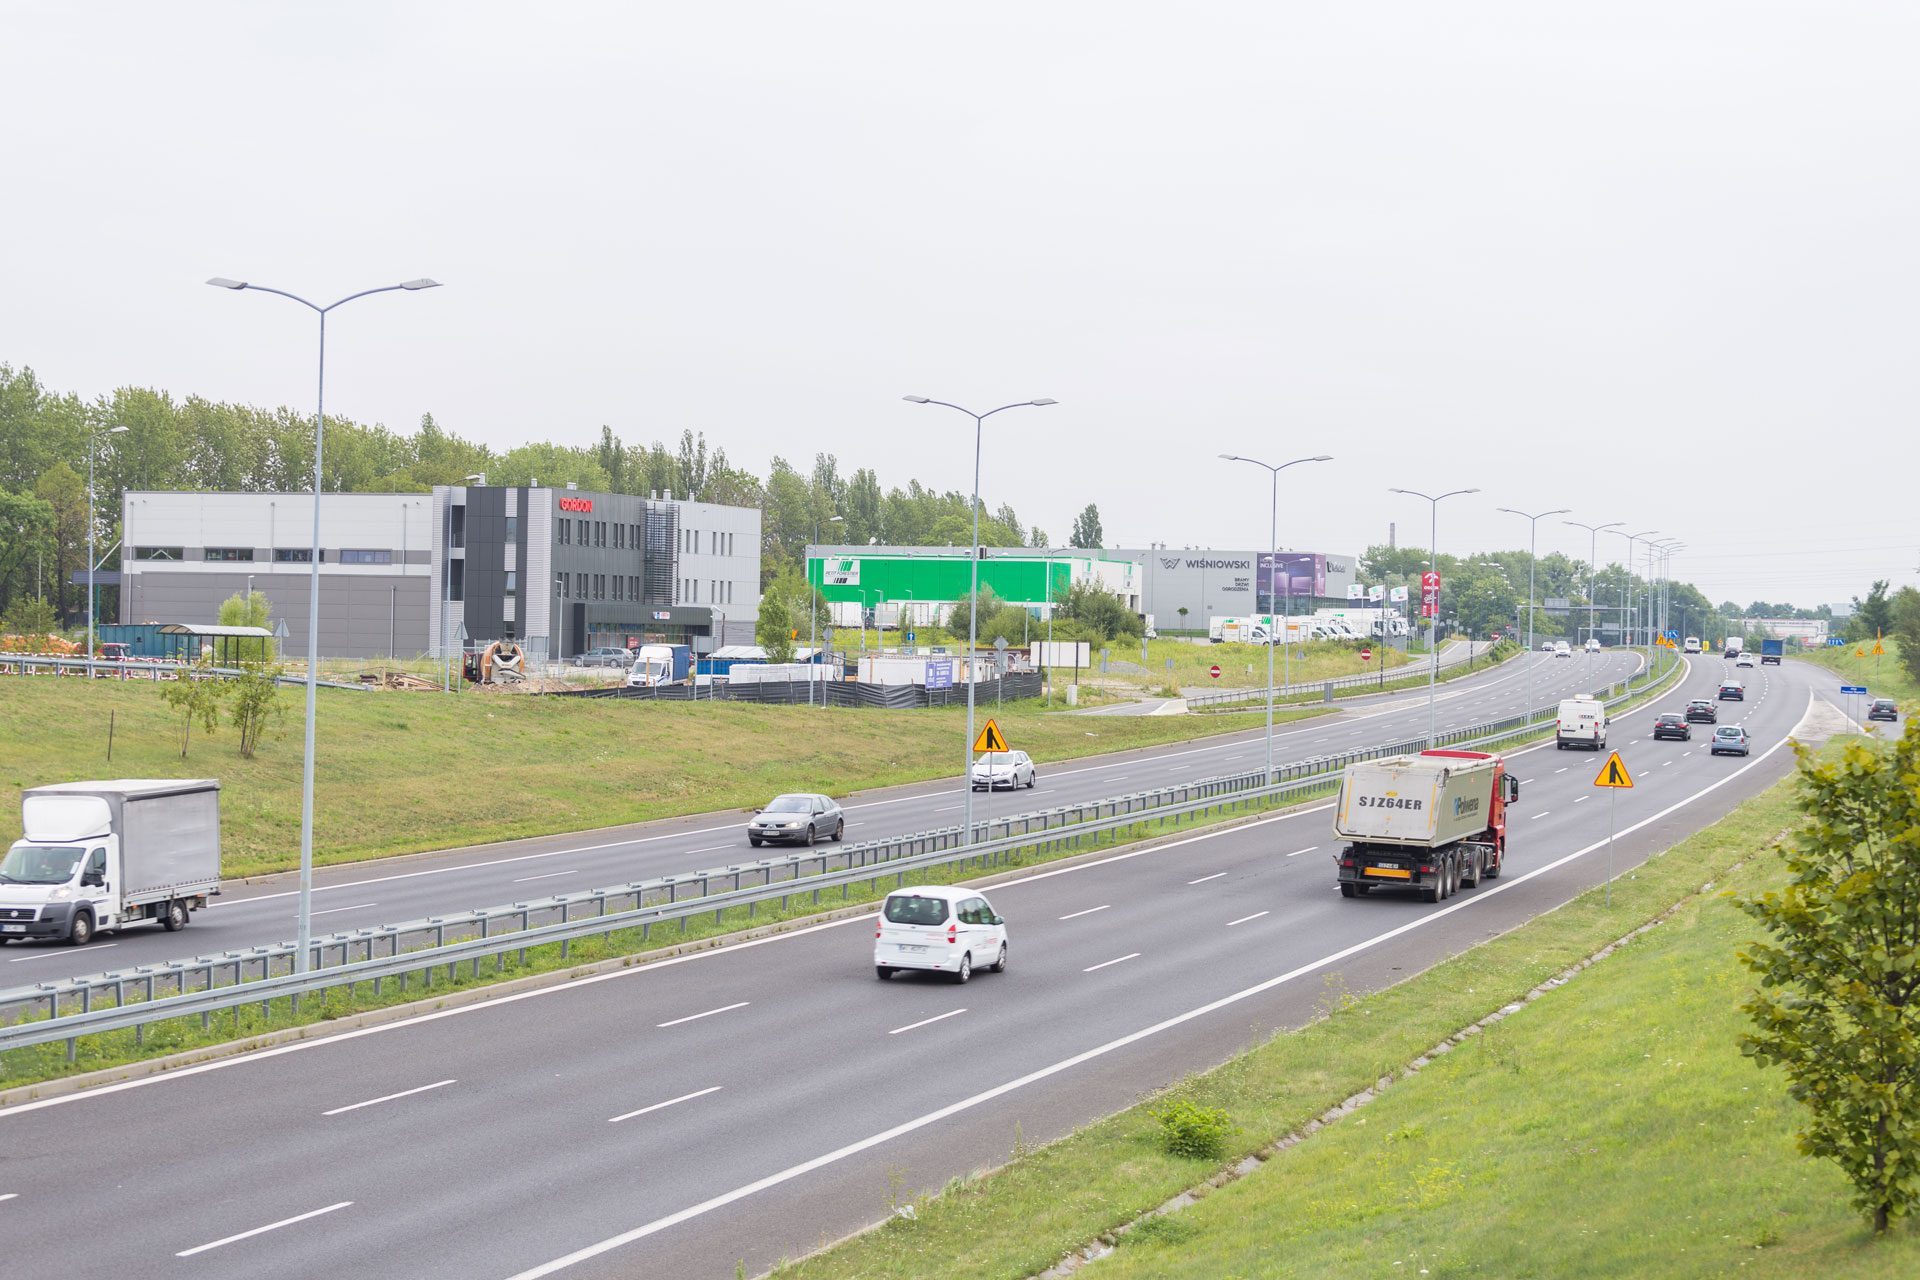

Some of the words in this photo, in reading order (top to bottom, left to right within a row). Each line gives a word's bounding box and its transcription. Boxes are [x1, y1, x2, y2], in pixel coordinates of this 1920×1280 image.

[560, 498, 592, 512] GORDON
[1185, 558, 1250, 569] WIŚNIOWSKI
[1359, 796, 1422, 810] SJZ64ER
